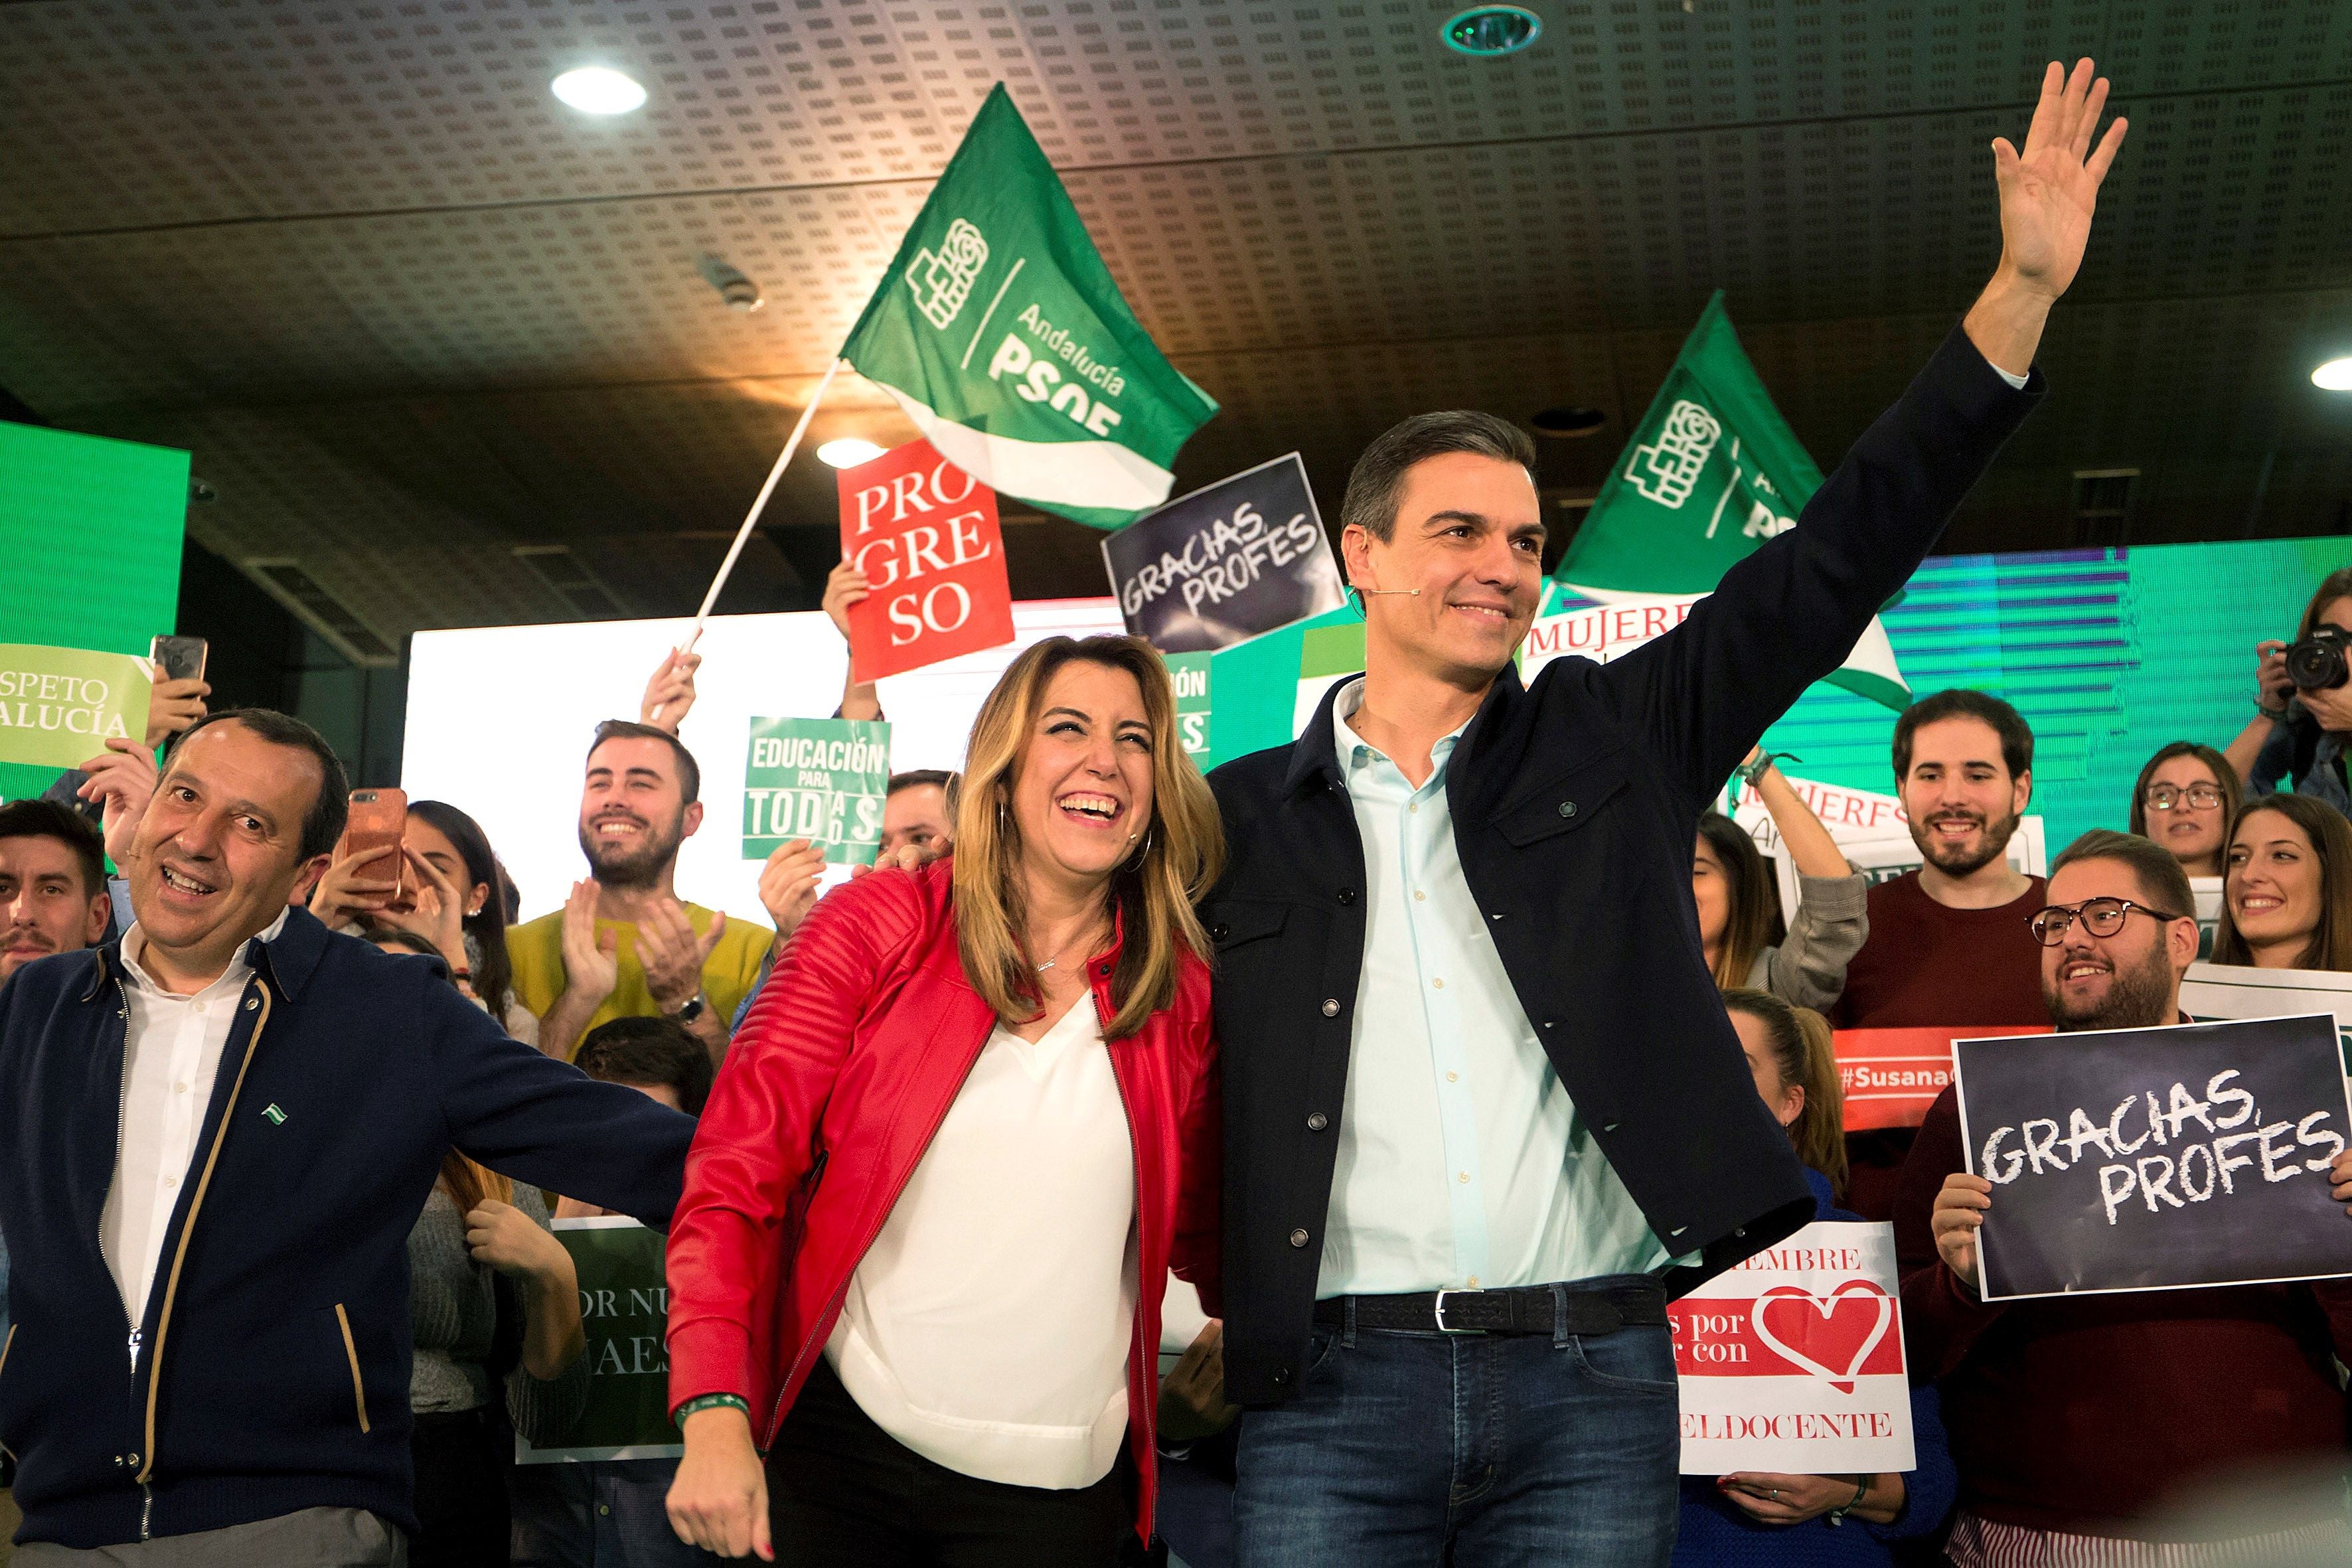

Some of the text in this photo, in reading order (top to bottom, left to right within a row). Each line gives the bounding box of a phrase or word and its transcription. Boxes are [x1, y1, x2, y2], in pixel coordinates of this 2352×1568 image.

[1017, 303, 1125, 397] Andalucía
[854, 459, 979, 536] PRO
[854, 510, 991, 591] GRE
[1181, 513, 1318, 618] PROFES
[888, 582, 971, 647] SO
[0, 670, 109, 705] SPETO
[752, 736, 885, 775] EDUCACIÓN
[798, 770, 832, 789] PARA
[1982, 1069, 2262, 1185] GRACIAS,
[2098, 1111, 2345, 1226] PROFES
[1730, 1248, 1862, 1271] EMBRE
[1689, 1314, 1745, 1342] por
[1692, 1343, 1751, 1362] con
[1680, 1413, 1893, 1440] ELDOCENTE
